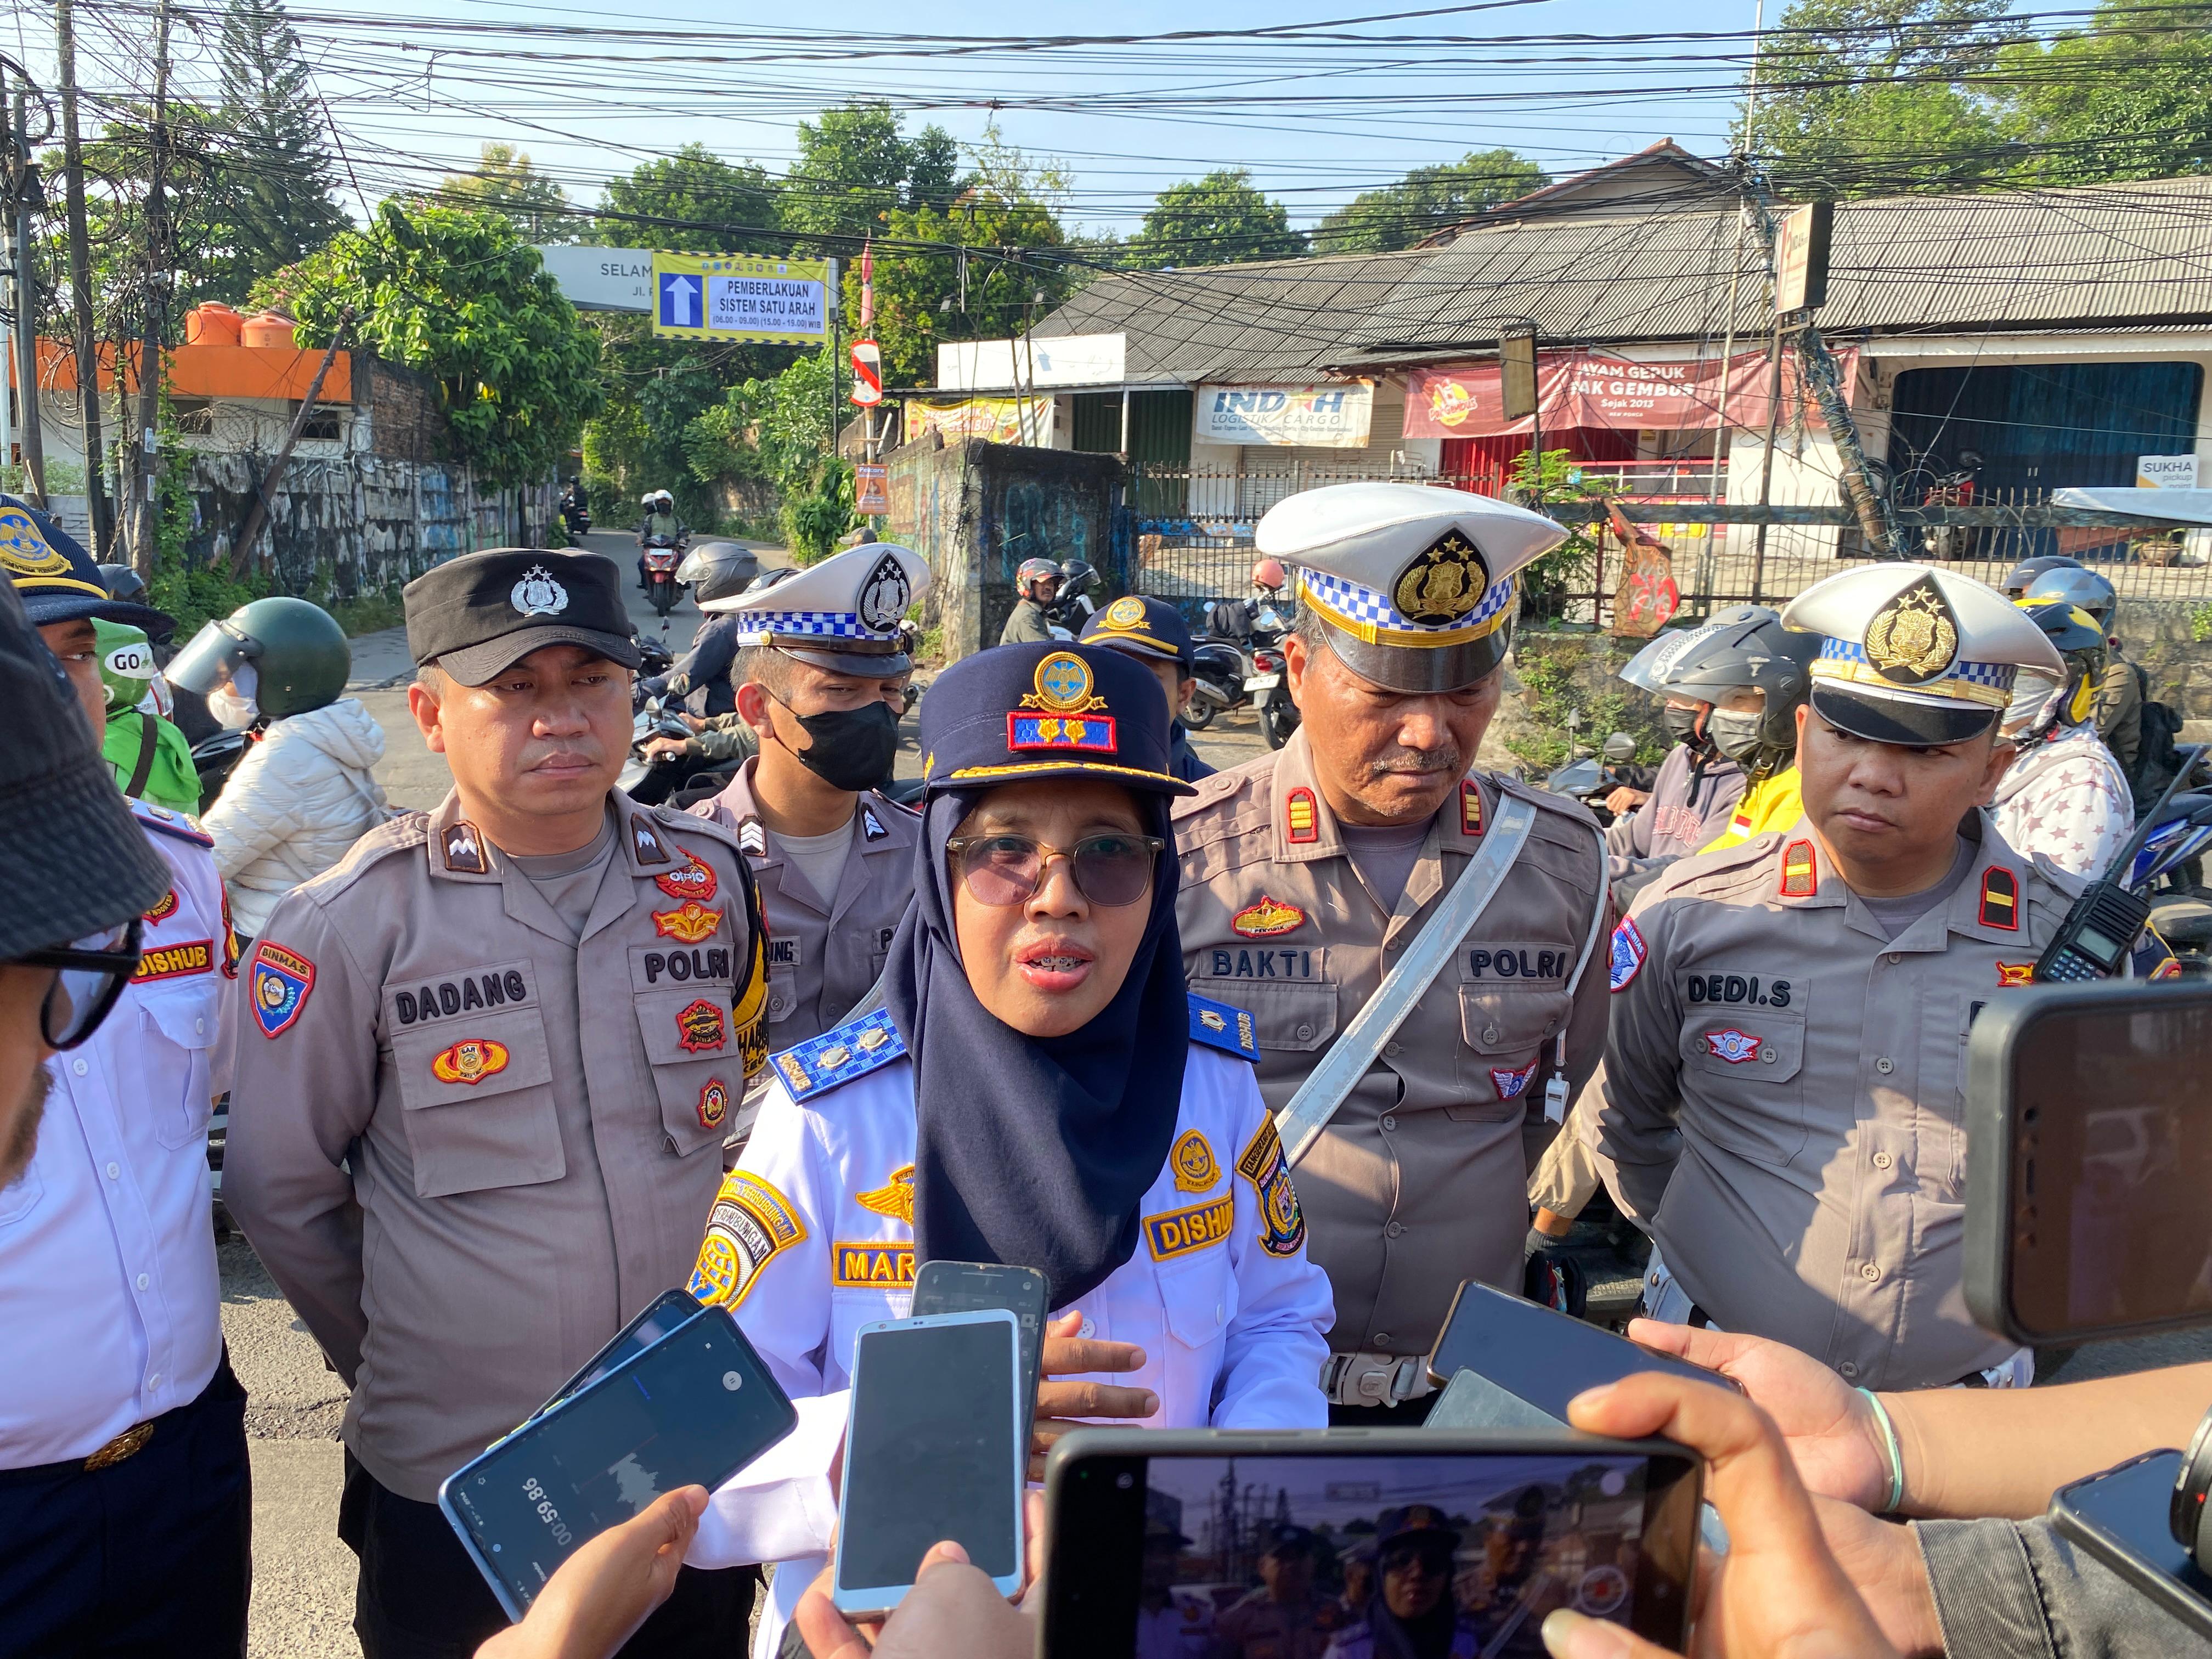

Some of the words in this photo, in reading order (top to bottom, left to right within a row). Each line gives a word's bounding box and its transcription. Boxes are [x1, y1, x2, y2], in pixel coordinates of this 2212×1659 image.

[633, 287, 645, 296] Jl.
[728, 281, 809, 297] PEMBERLAKUAN
[720, 298, 757, 313] SISTEM
[760, 301, 785, 314] SATU
[788, 302, 815, 315] ARAH
[739, 317, 759, 326] 09.00)
[761, 318, 781, 327] (15.00
[787, 319, 807, 329] 19.00)
[1577, 363, 1624, 377] AYAM
[1628, 366, 1685, 380] GEPUK
[1252, 383, 1295, 392] EXPRESS
[1571, 380, 1604, 395] PAK
[1610, 382, 1695, 397] GEMBUS
[1601, 398, 1628, 409] Sejak
[1630, 399, 1654, 408] 2013
[1212, 414, 1270, 424] LOGISTIK
[1284, 415, 1340, 424] CARGO
[2143, 462, 2193, 472] SUKHA
[114, 654, 139, 670] GO
[262, 947, 307, 974] BINMAS
[645, 948, 730, 984] POLRI
[1212, 950, 1310, 977] BAKTI
[1470, 949, 1566, 978] POLRI
[396, 970, 527, 1024] DADANG
[1688, 975, 1791, 1007] DEDI.S
[1238, 1012, 1254, 1052] DISHUB
[777, 1052, 813, 1092] DISHUB
[741, 1182, 792, 1240] PERHUBUNGAN
[522, 1477, 573, 1546] 00:59.86
